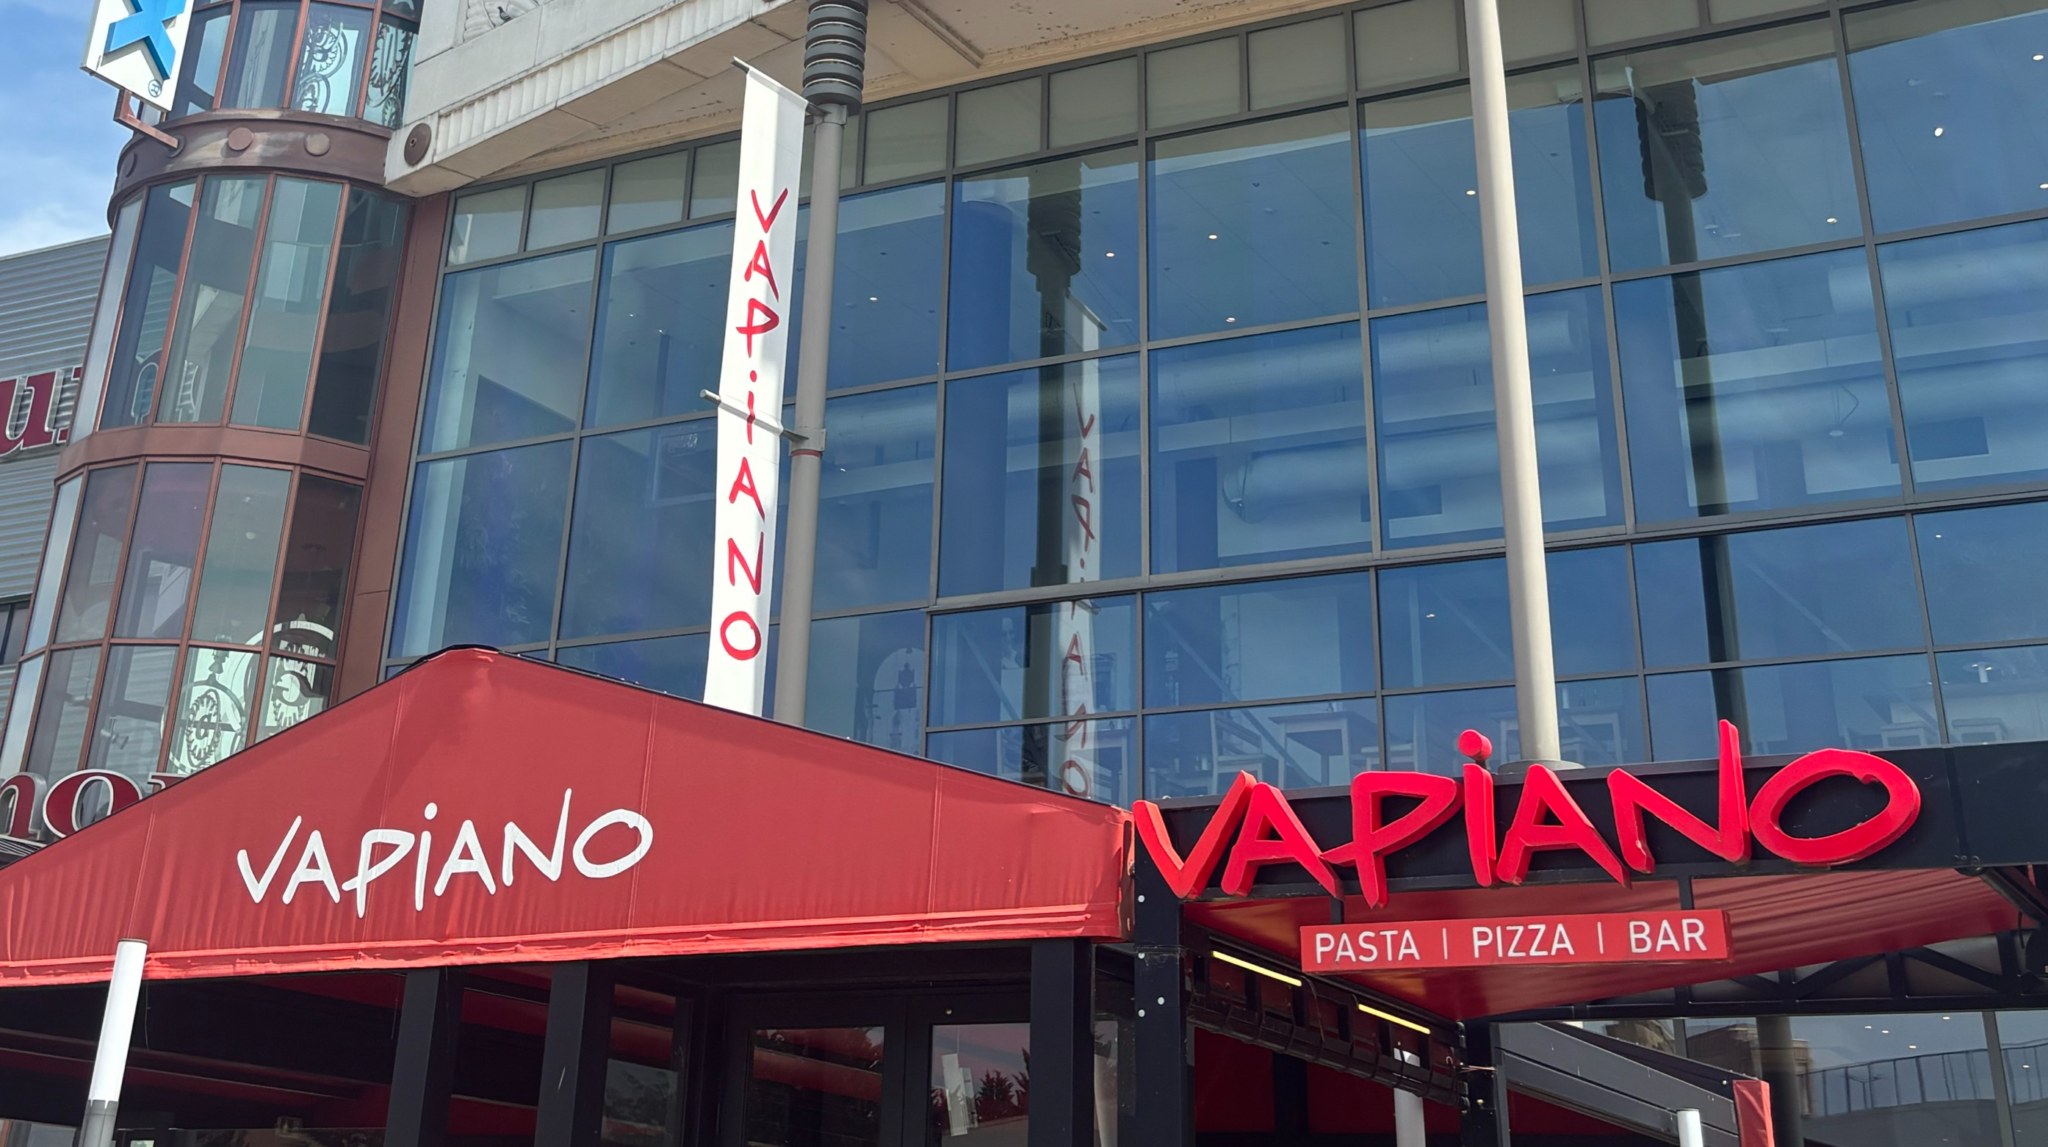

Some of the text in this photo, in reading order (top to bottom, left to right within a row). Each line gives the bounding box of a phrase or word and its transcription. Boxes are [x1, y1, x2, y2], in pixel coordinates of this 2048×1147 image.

[1315, 918, 1708, 964] PASTA PIZZA BAR
